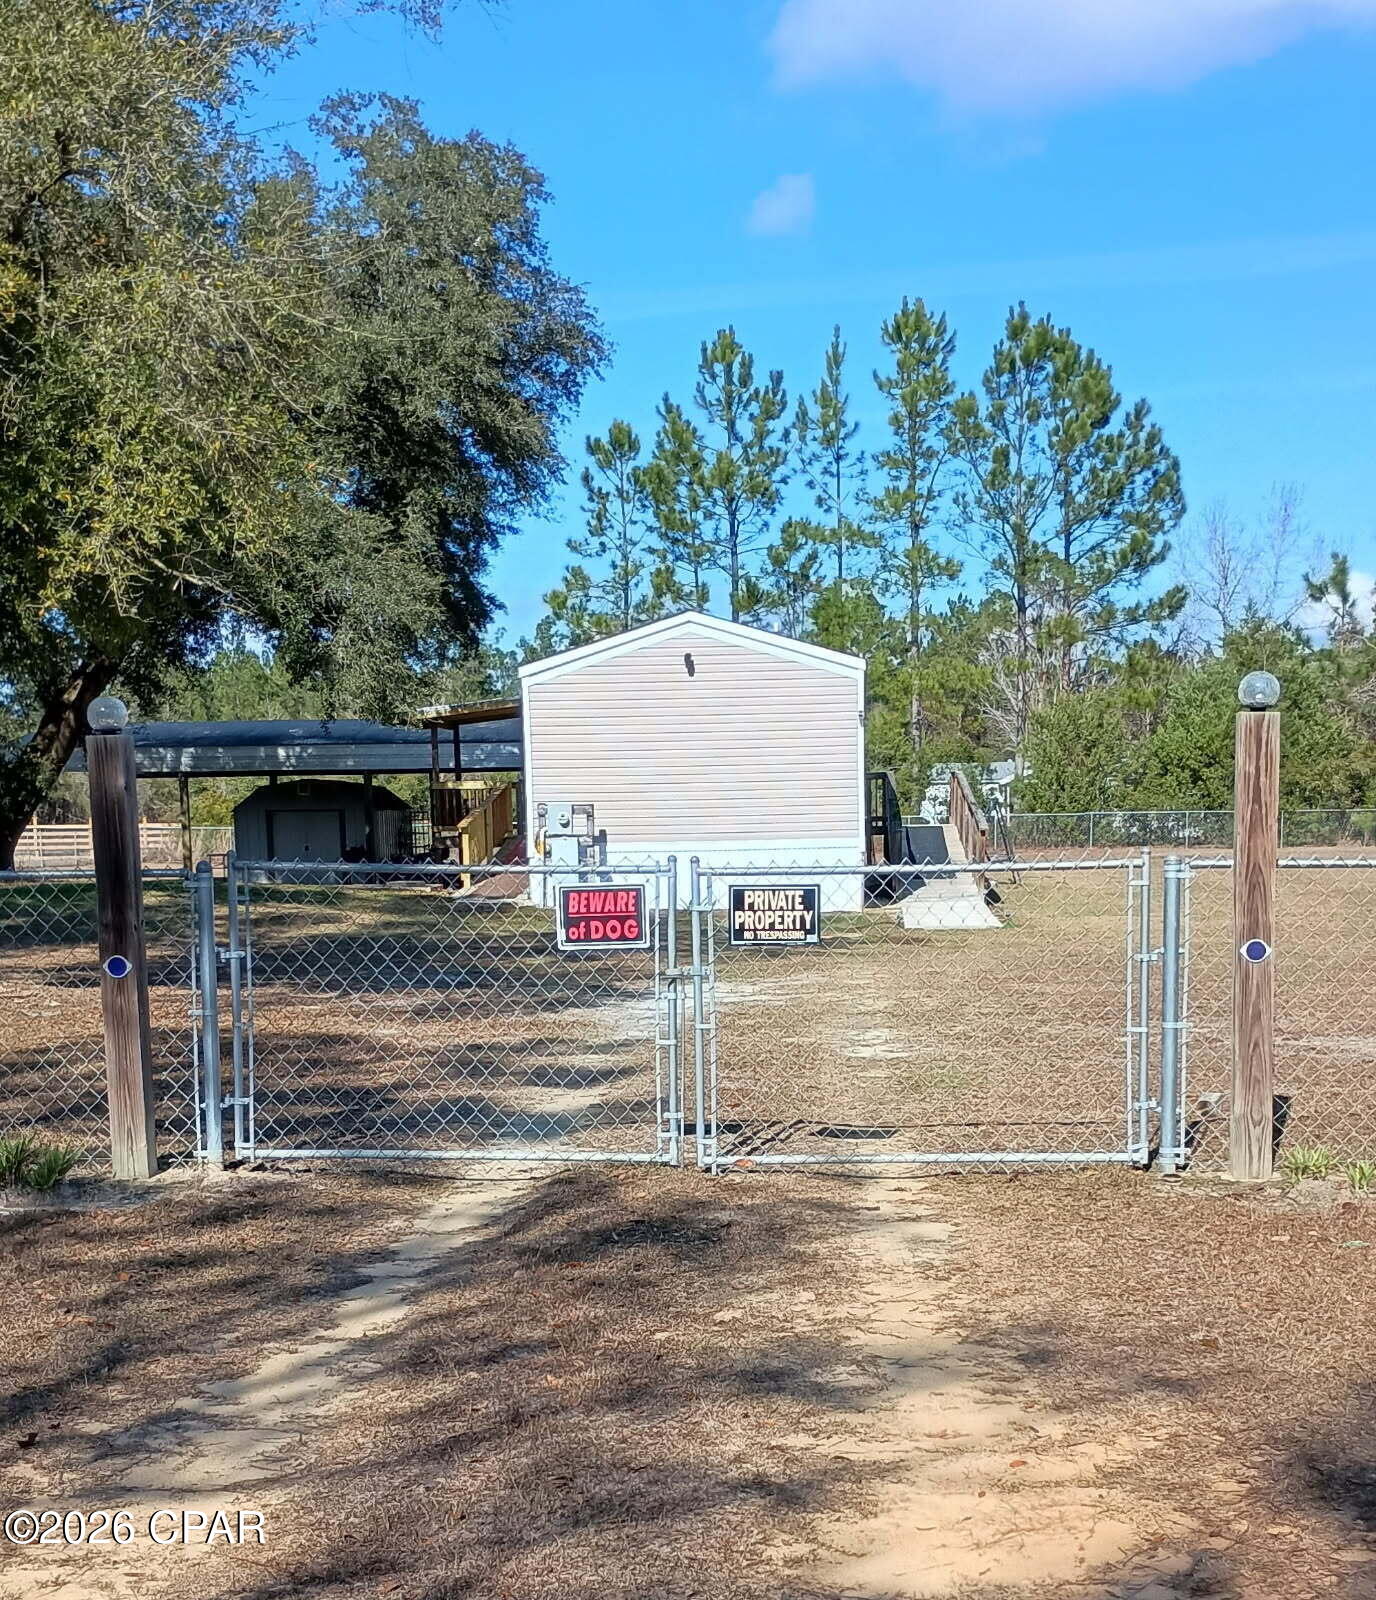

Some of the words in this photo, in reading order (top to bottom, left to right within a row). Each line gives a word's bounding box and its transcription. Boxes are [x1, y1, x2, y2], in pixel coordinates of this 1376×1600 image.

[568, 891, 637, 913] BEWARE
[744, 890, 804, 910] PRIVATE
[568, 921, 586, 940] of
[590, 919, 639, 940] DOG
[734, 910, 813, 930] PROPERTY
[743, 930, 754, 940] NO
[756, 930, 805, 940] TRESPASSING
